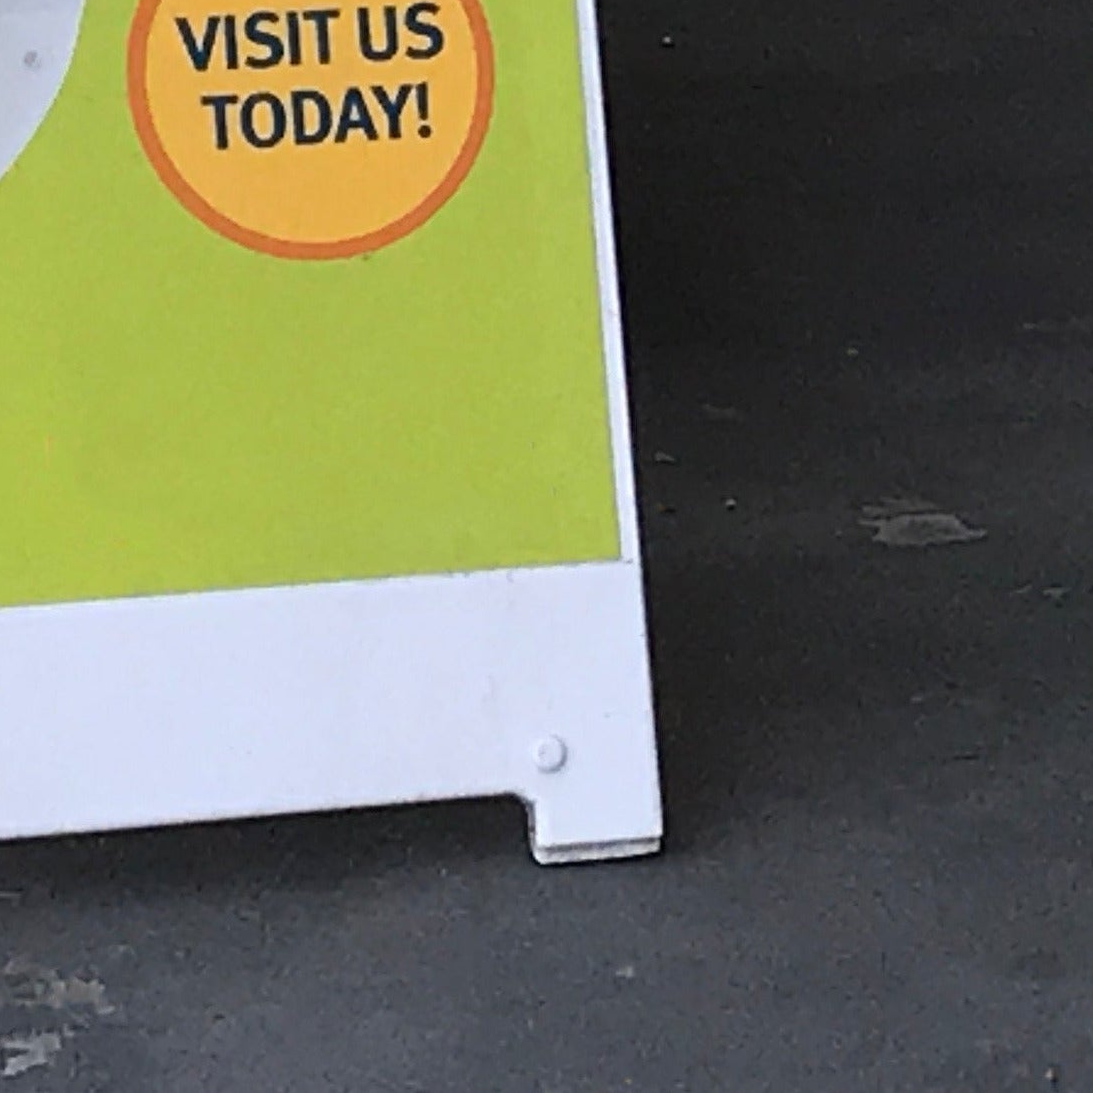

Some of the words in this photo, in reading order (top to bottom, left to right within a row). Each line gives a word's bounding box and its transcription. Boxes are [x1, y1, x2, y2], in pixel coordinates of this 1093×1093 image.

[175, 9, 340, 72] VISIT
[357, 2, 444, 62] US
[201, 82, 432, 150] TODAY!
